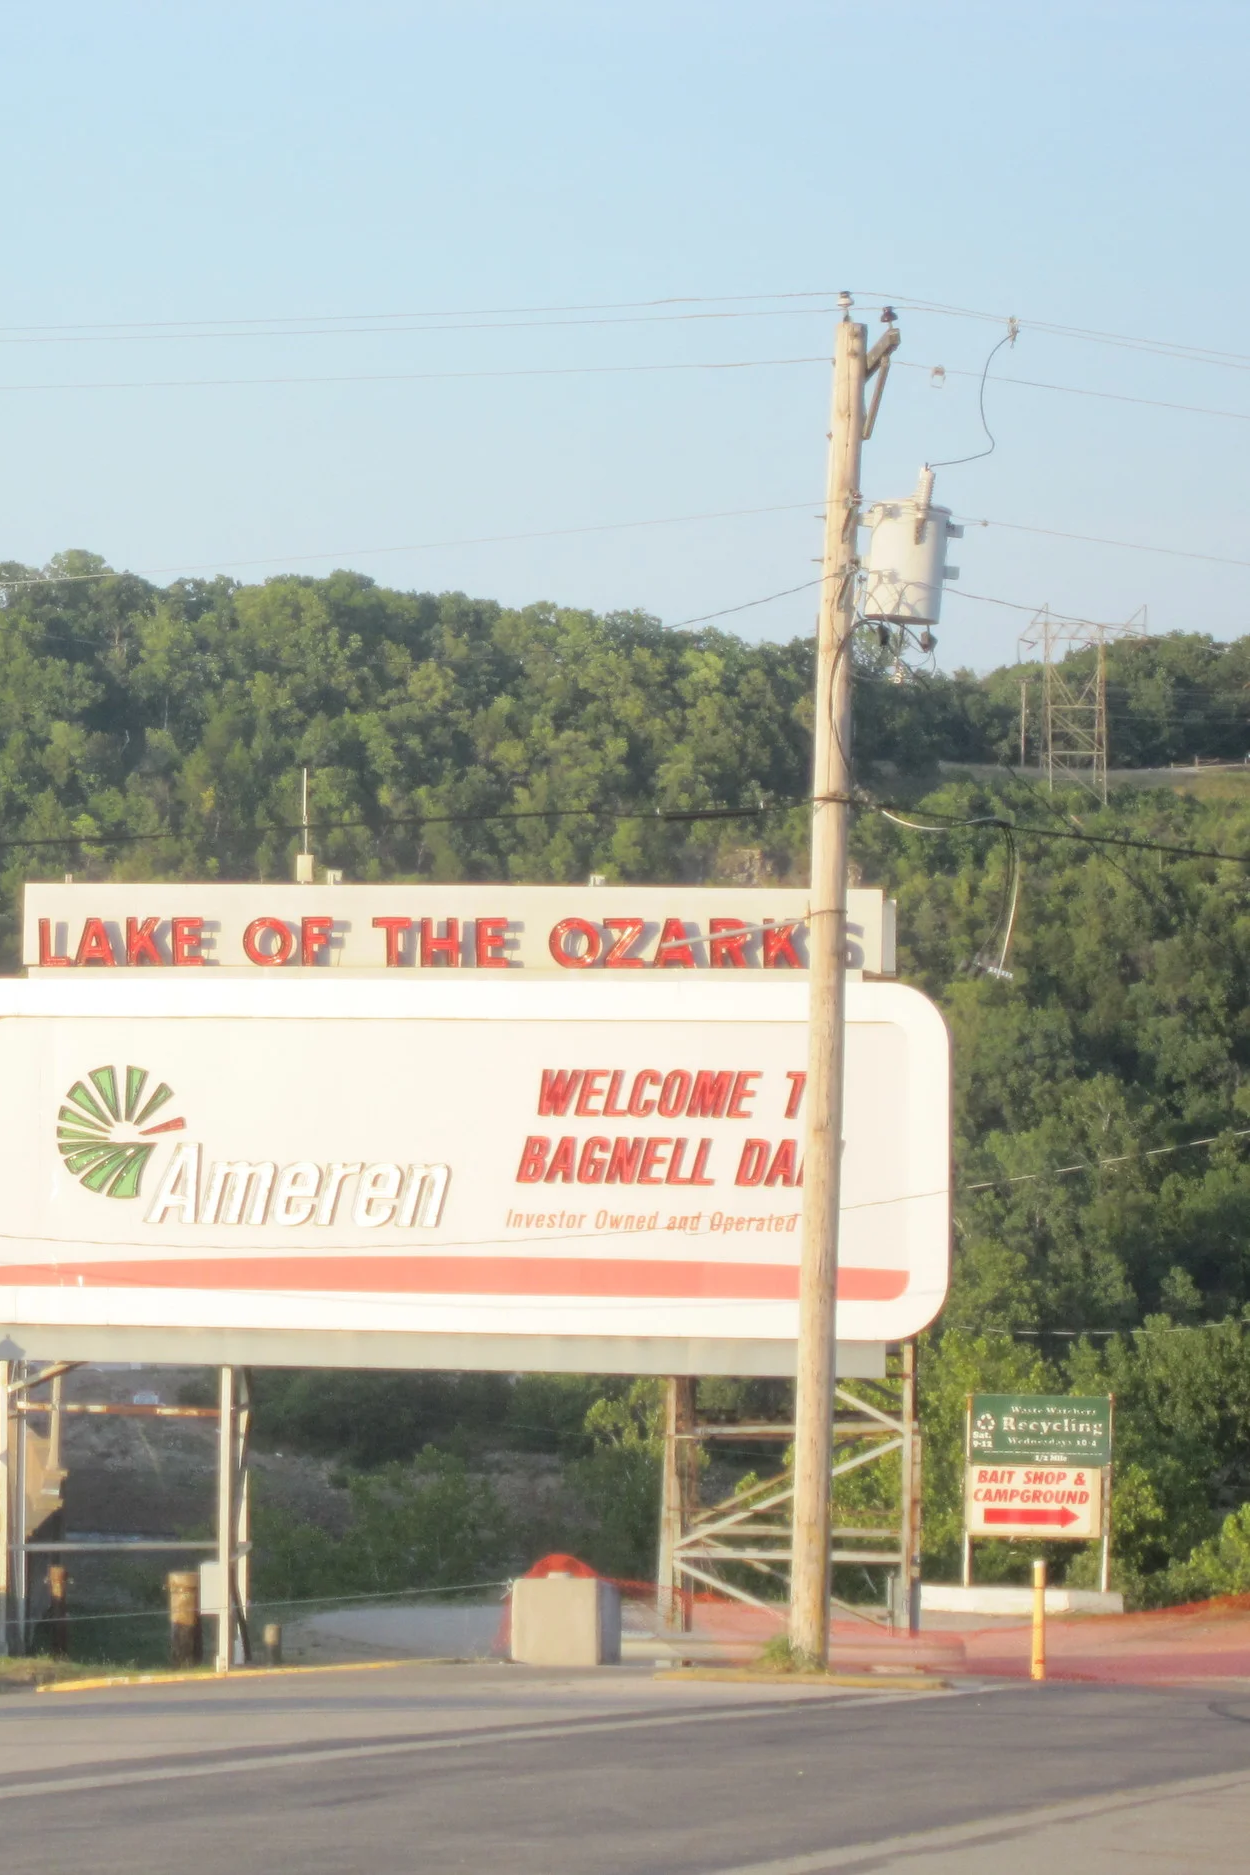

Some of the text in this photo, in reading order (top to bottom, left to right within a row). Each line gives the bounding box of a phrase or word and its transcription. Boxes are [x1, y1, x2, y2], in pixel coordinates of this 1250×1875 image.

[38, 917, 806, 969] LAKE OF THE OZARK
[537, 1069, 808, 1119] WELCOME T
[516, 1136, 805, 1188] BAGNELL DA
[142, 1142, 452, 1228] Ameren
[505, 1209, 798, 1233] Investor Owned and Operated
[972, 1431, 992, 1440] Sat.
[1002, 1416, 1102, 1436] Recycling
[972, 1440, 993, 1449] 9-12
[977, 1470, 1086, 1486] BAIT SHOP &
[973, 1488, 1090, 1505] CAMPGROUND
